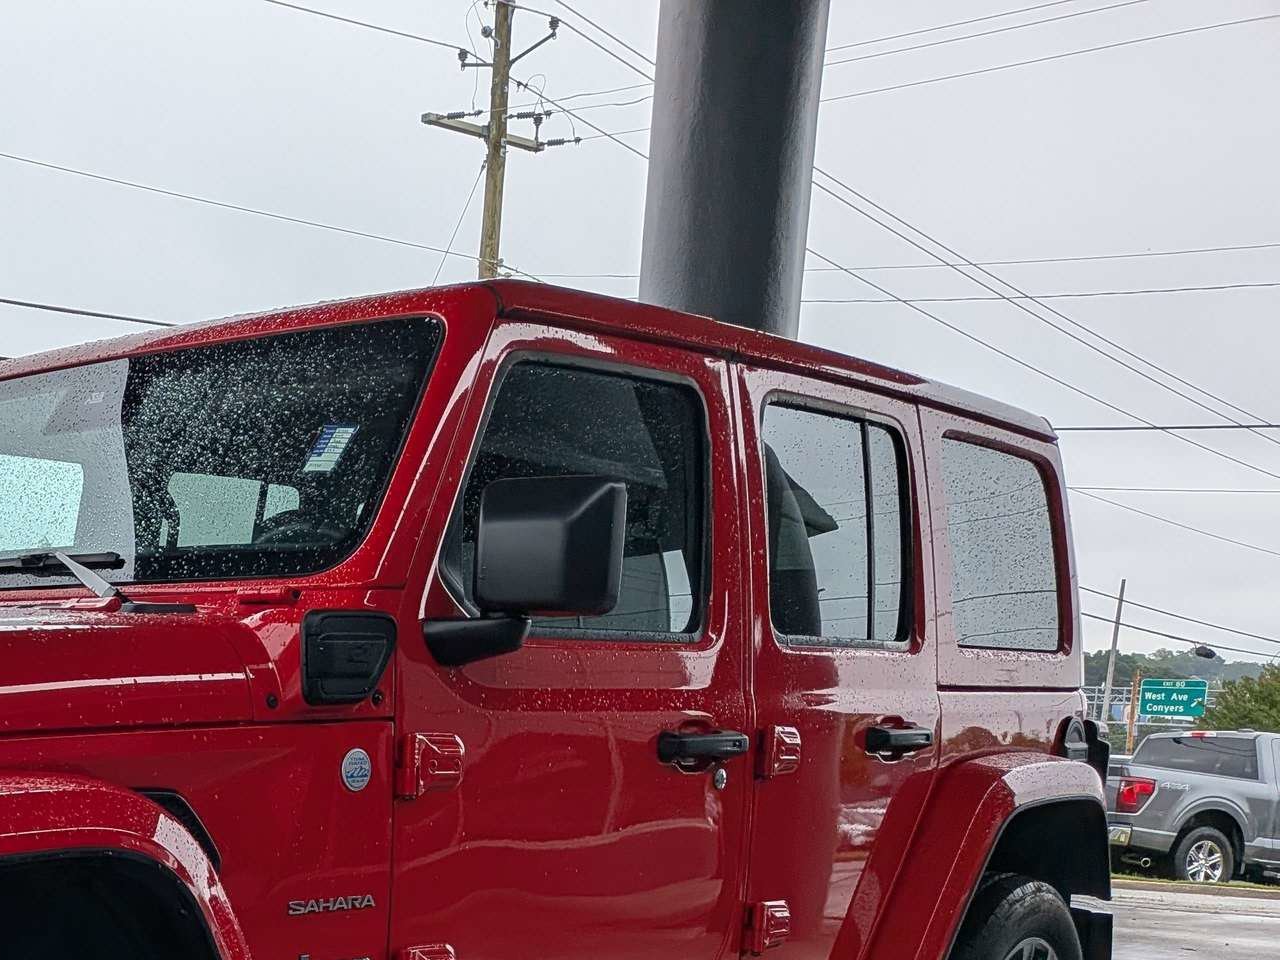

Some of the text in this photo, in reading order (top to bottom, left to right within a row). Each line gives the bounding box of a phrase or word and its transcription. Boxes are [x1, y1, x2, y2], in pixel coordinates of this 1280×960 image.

[1145, 692, 1189, 701] West Ave
[1146, 704, 1184, 713] Conyers
[288, 894, 375, 915] SAHARA
